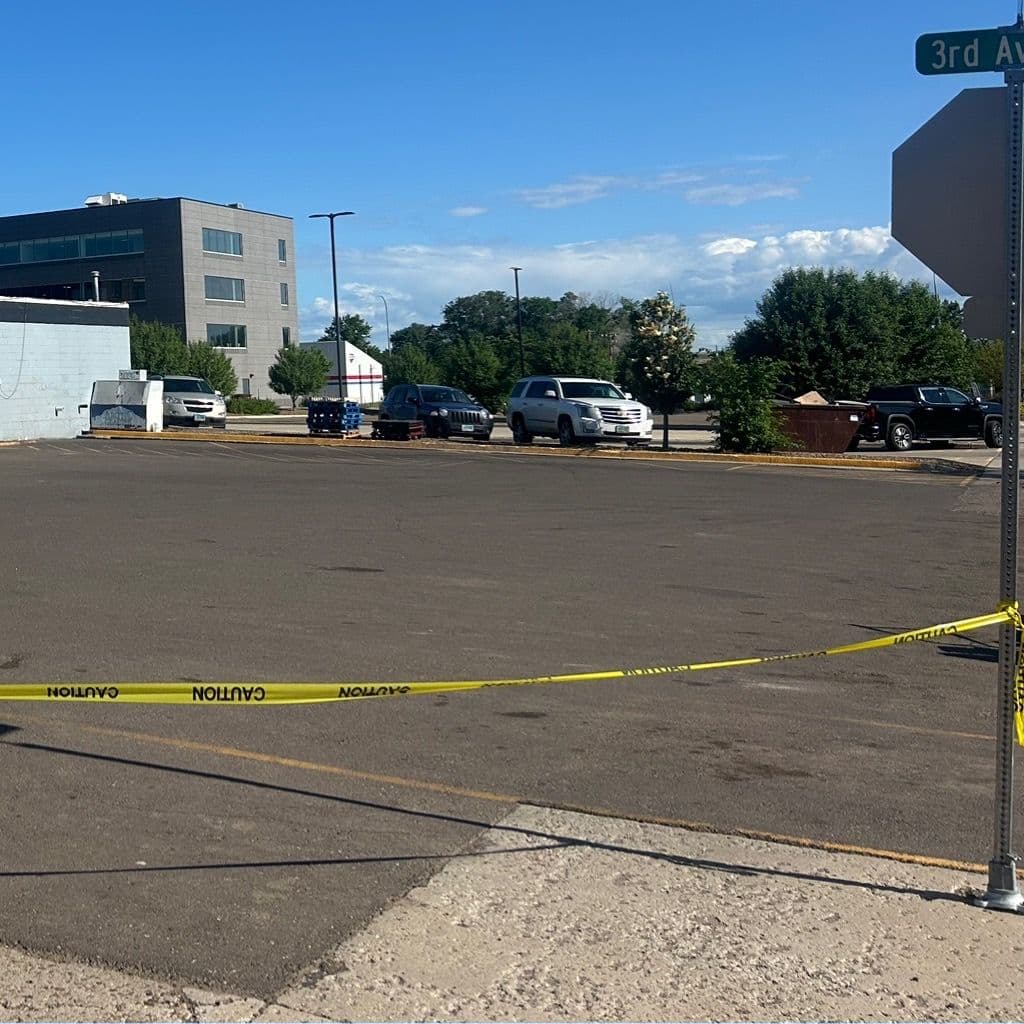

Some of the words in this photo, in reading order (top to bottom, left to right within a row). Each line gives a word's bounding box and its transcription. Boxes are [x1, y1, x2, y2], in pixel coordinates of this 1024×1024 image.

[931, 38, 979, 69] 3rd
[47, 686, 119, 698] CAUTION
[192, 687, 266, 701] CAUTION
[338, 686, 411, 698] CAUTION
